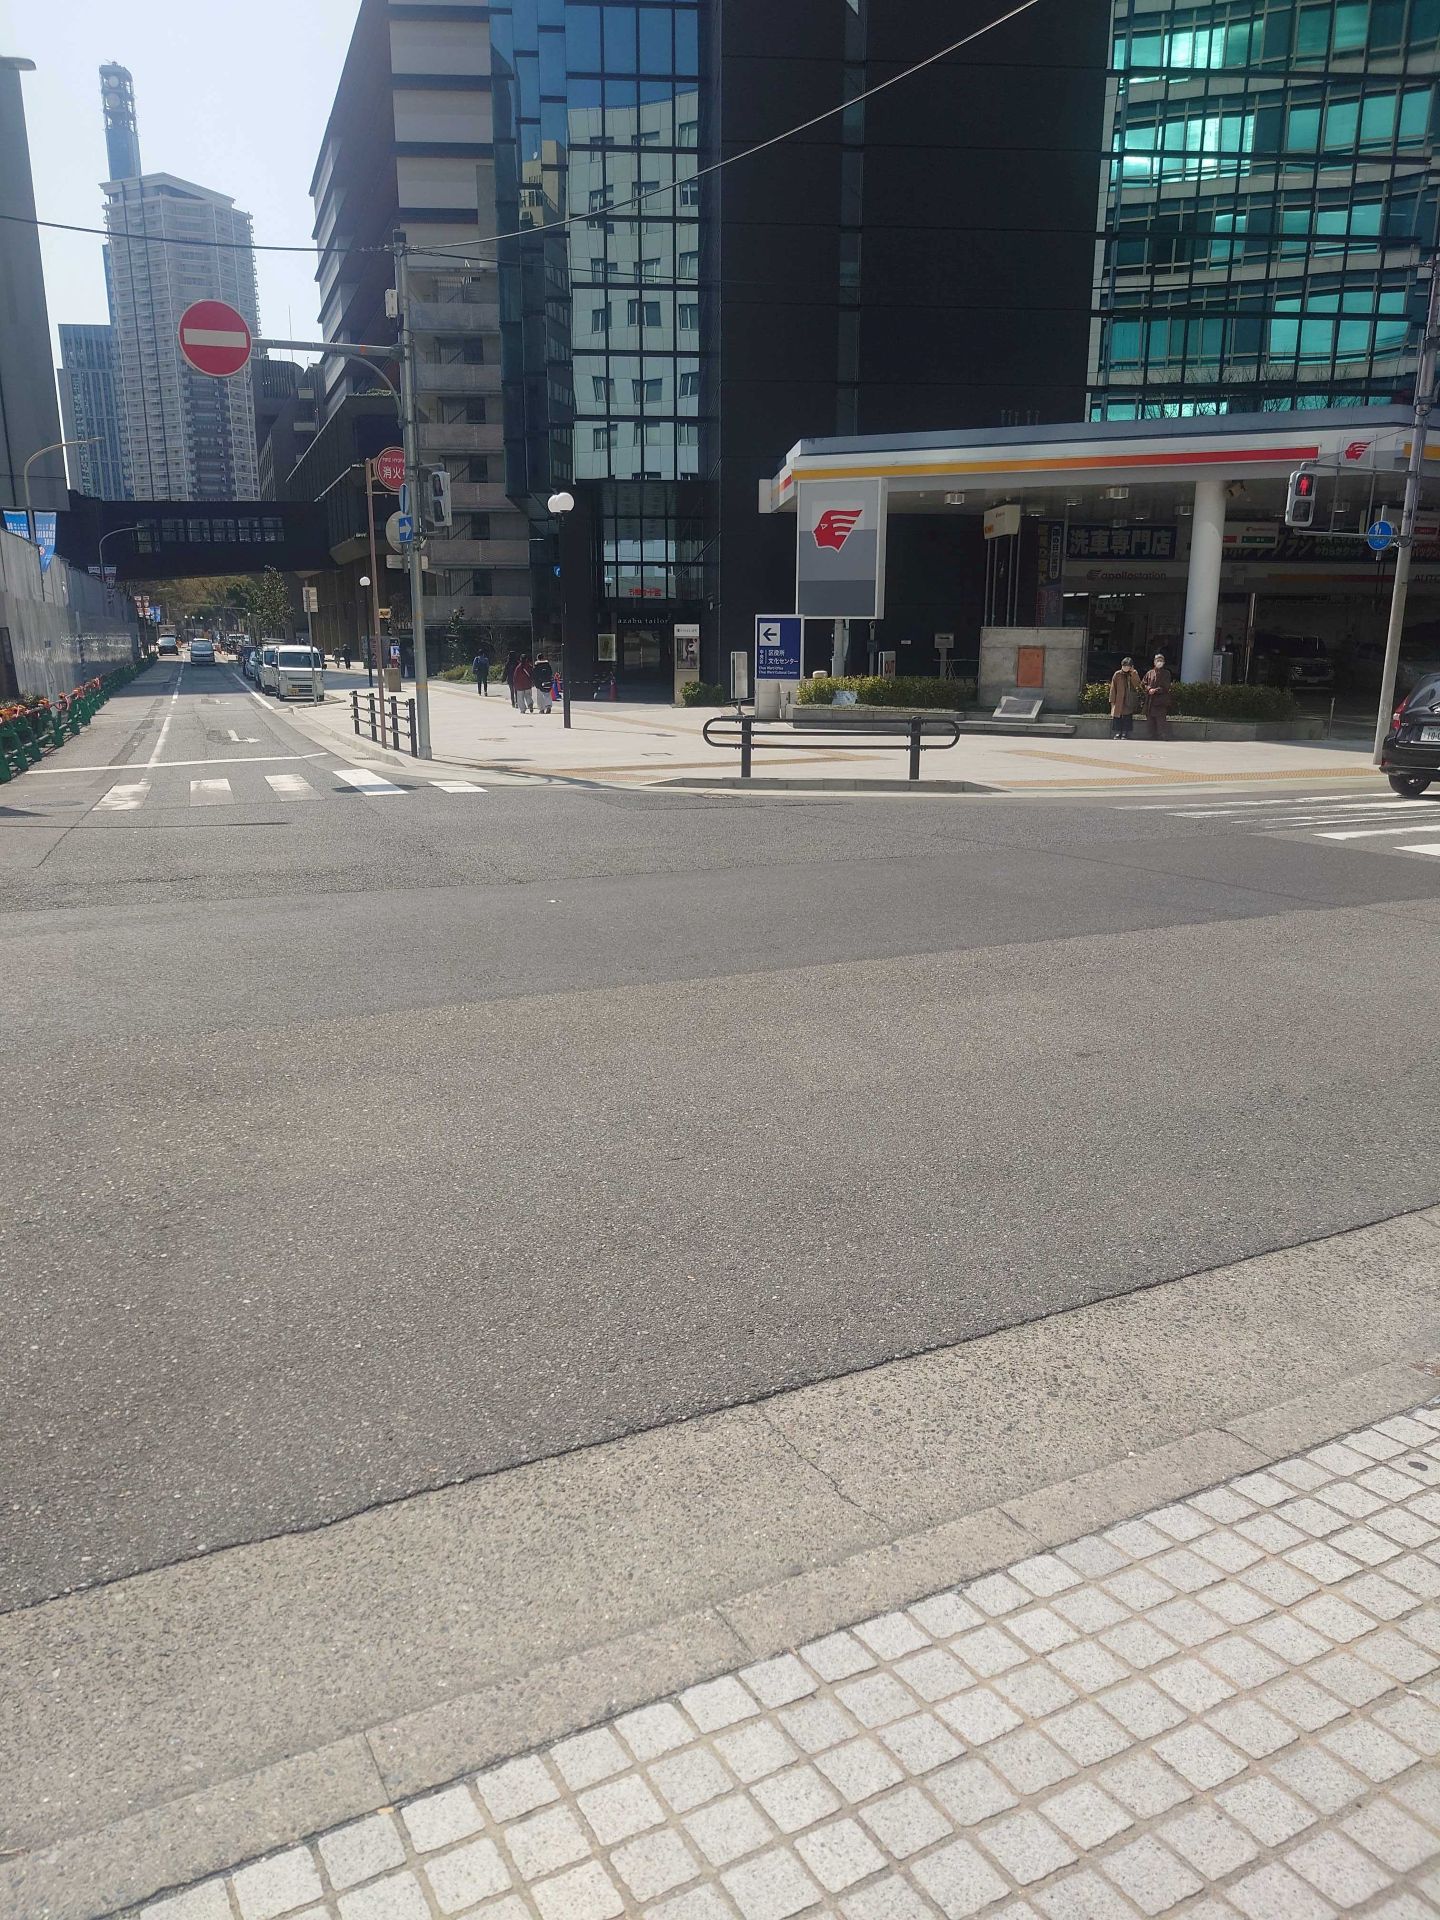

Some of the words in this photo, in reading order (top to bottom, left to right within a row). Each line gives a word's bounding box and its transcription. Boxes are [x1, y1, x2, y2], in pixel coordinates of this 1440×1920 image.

[383, 466, 405, 479] 消火
[1069, 528, 1172, 556] 洗車専門店
[1101, 569, 1167, 581] apollostation
[768, 649, 785, 657] 区役所
[768, 657, 799, 665] 文化センター
[885, 661, 895, 674] OUT
